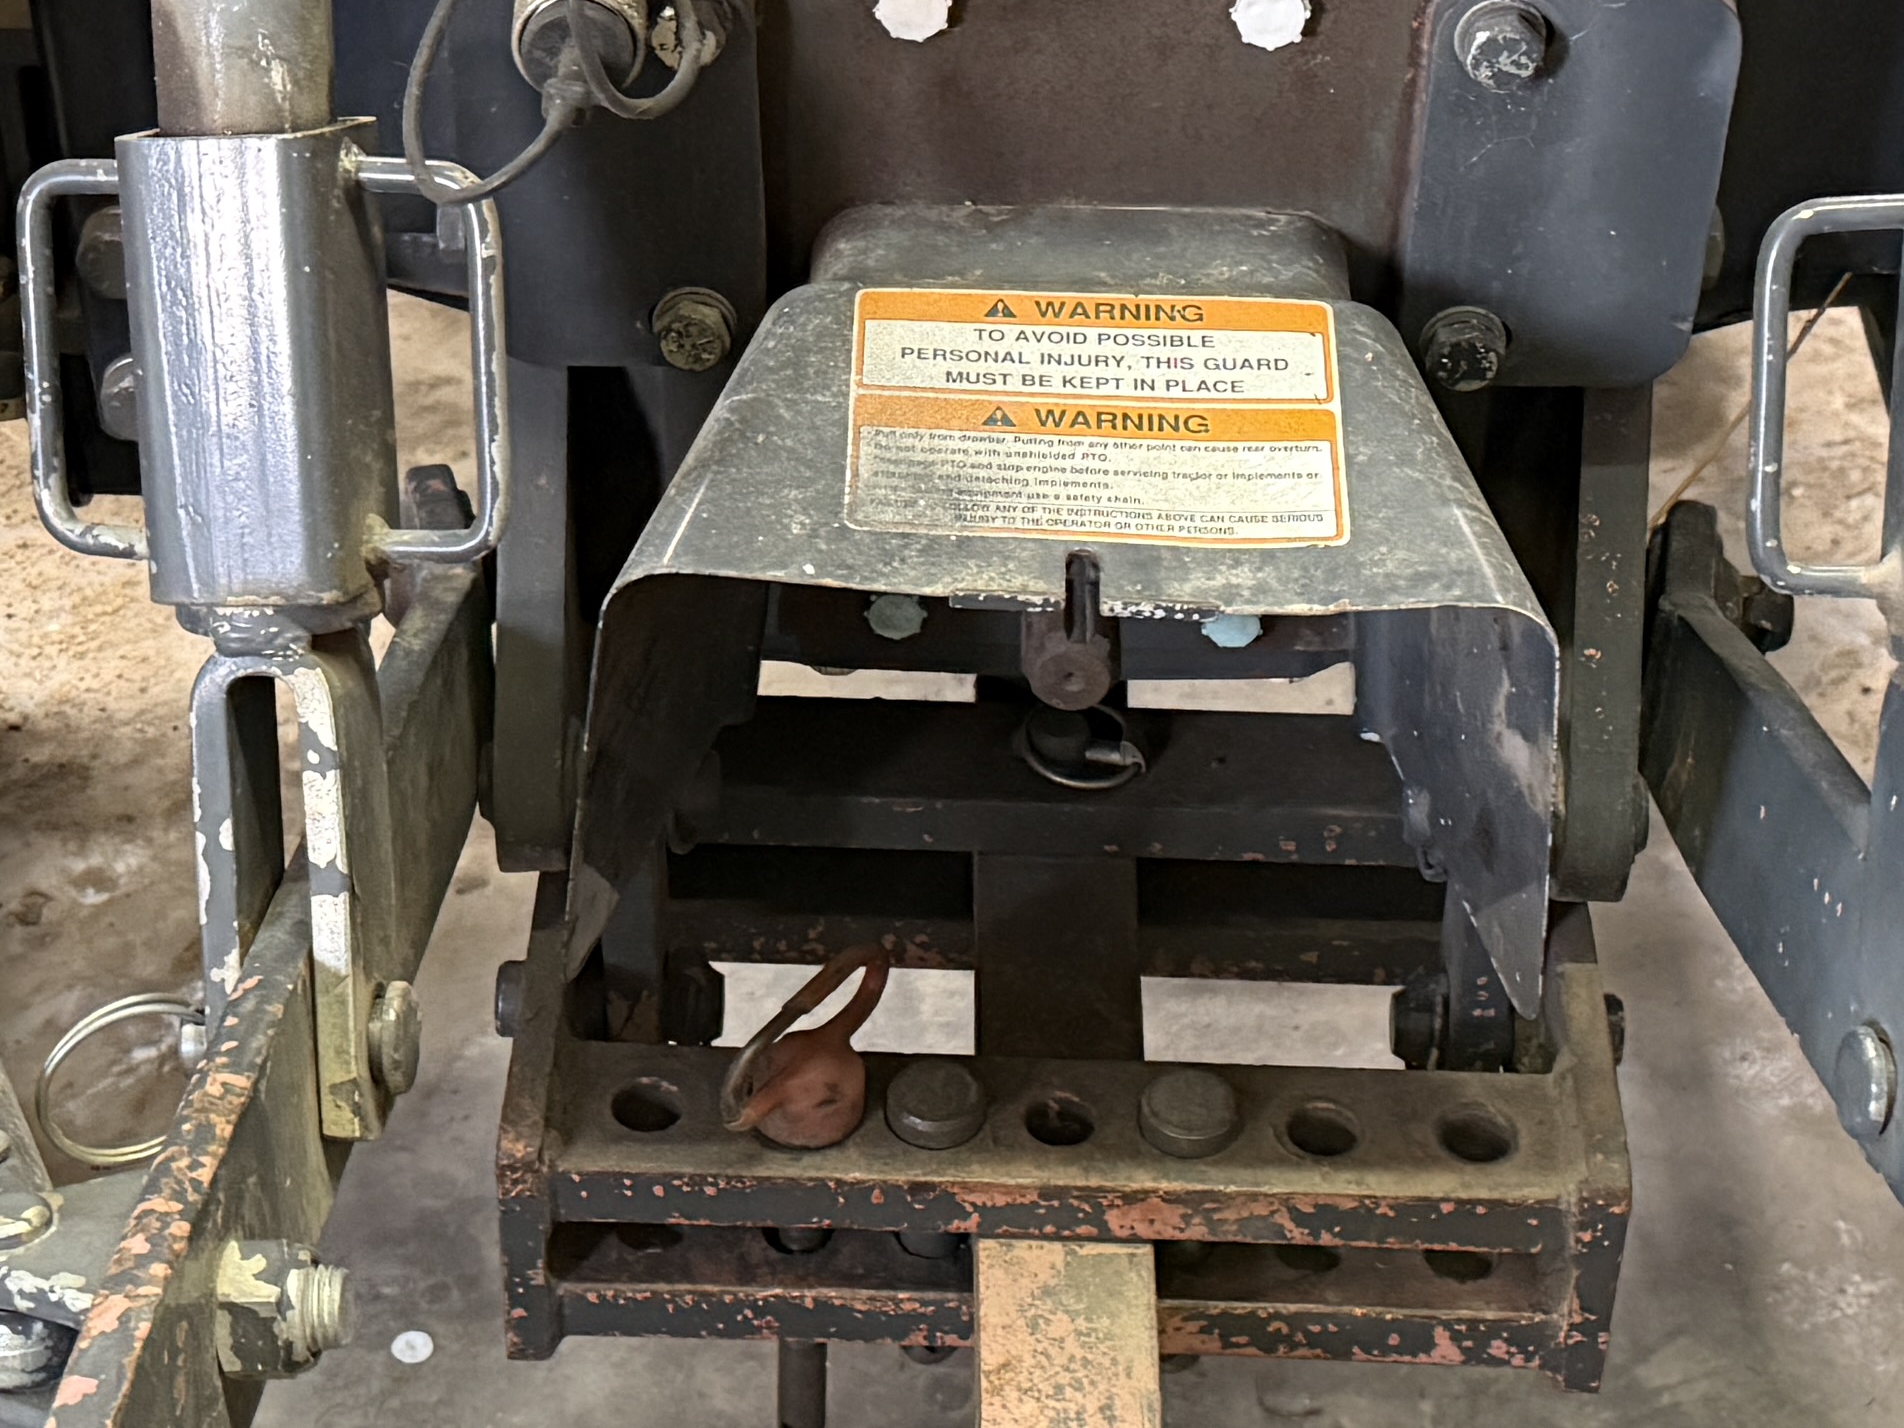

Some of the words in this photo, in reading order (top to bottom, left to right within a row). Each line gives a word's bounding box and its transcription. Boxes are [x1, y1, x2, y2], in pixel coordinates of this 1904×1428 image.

[1034, 300, 1205, 323] WARNING
[974, 328, 1006, 342] TO
[1015, 329, 1088, 345] AVOID
[1097, 332, 1216, 349] POSSIBLE
[901, 347, 1031, 365] PERSONAL
[1040, 352, 1133, 372] INJURY,
[1141, 356, 1195, 370] THIS
[1203, 357, 1290, 372] GUARD
[945, 371, 1013, 386] MUST
[1021, 374, 1054, 388] BE
[1062, 375, 1125, 391] KEPT
[1133, 377, 1156, 392] IN
[1165, 379, 1246, 393] PLACE
[1034, 407, 1211, 434] WARNING
[928, 432, 956, 443] from
[1057, 438, 1085, 448] from
[1088, 440, 1109, 451] any
[1112, 441, 1143, 451] other
[1146, 443, 1177, 453] point
[1180, 445, 1201, 453] can
[1204, 445, 1239, 453] cause
[1242, 444, 1266, 452] rear
[973, 447, 1002, 458] with
[1005, 450, 1076, 461] unshielded
[1080, 452, 1112, 463] PTO.
[969, 460, 993, 471] and
[996, 462, 1024, 473] stop
[1025, 464, 1067, 475] engine
[1070, 465, 1110, 476] before
[1112, 468, 1169, 480] servicing
[1171, 470, 1213, 482] tractor
[1215, 472, 1228, 481] or
[1232, 470, 1304, 482] implements
[1306, 472, 1319, 480] or
[965, 474, 1030, 488] detaching
[1034, 476, 1114, 490] implements.
[1027, 490, 1051, 501] use
[1065, 492, 1103, 504] safety
[1106, 494, 1145, 506] chain.
[995, 504, 1019, 514] ANY
[1021, 505, 1038, 514] OF
[1041, 506, 1065, 516] THE
[1067, 508, 1154, 521] INSTRUCTIONS
[1157, 512, 1197, 523] ABOVE
[1199, 514, 1225, 524] CAN
[1228, 514, 1269, 524] CAUSE
[1271, 513, 1324, 524] SERIOUS
[1001, 515, 1017, 525] TO
[1020, 516, 1044, 527] THE
[1045, 517, 1112, 529] OPERATOR
[1114, 521, 1132, 530] OR
[1134, 522, 1176, 533] OTHER
[1178, 525, 1239, 536] PERSONS.
